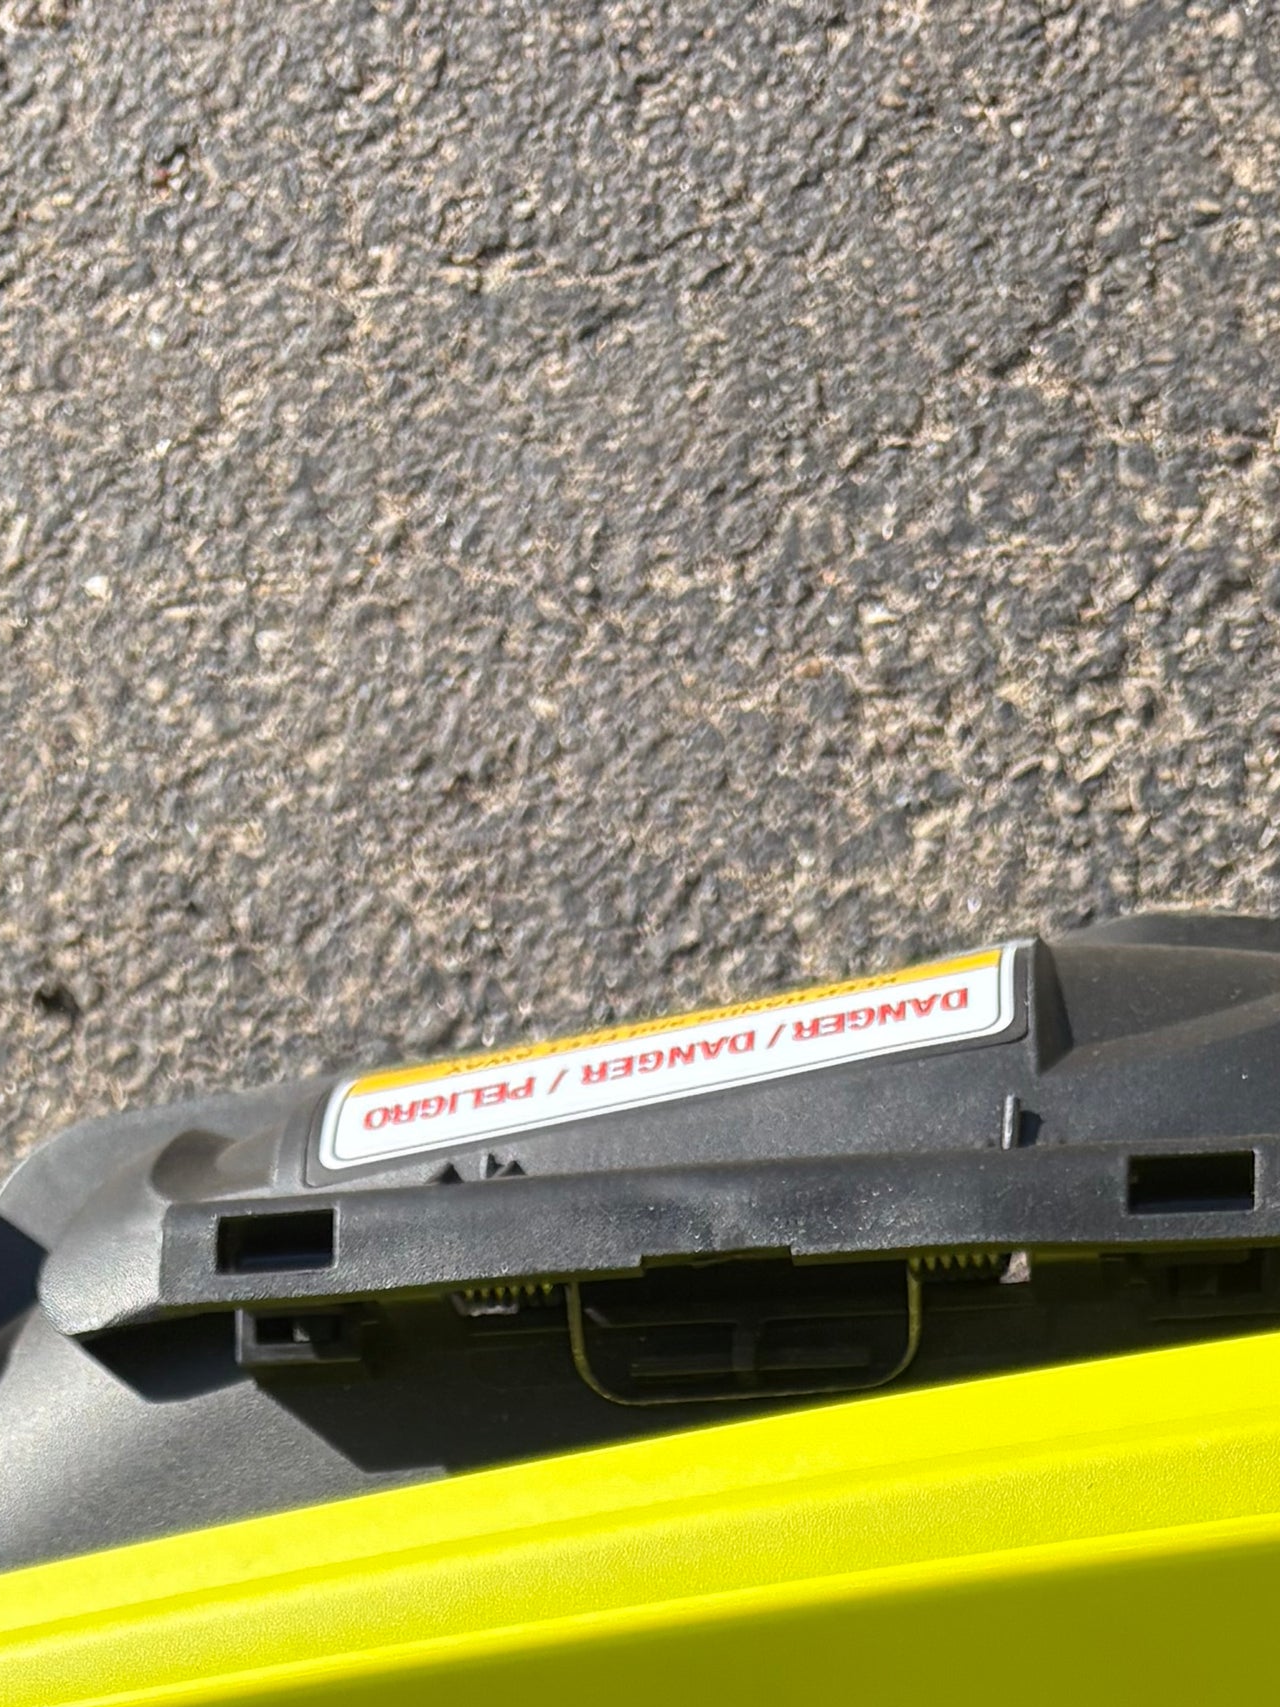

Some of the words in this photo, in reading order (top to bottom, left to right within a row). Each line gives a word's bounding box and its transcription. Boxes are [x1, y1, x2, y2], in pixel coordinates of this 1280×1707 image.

[767, 1024, 785, 1048] /
[791, 987, 970, 1044] DANGER
[548, 1069, 567, 1094] /
[581, 1030, 757, 1086] DANGER
[362, 1076, 537, 1132] PELIGRO
